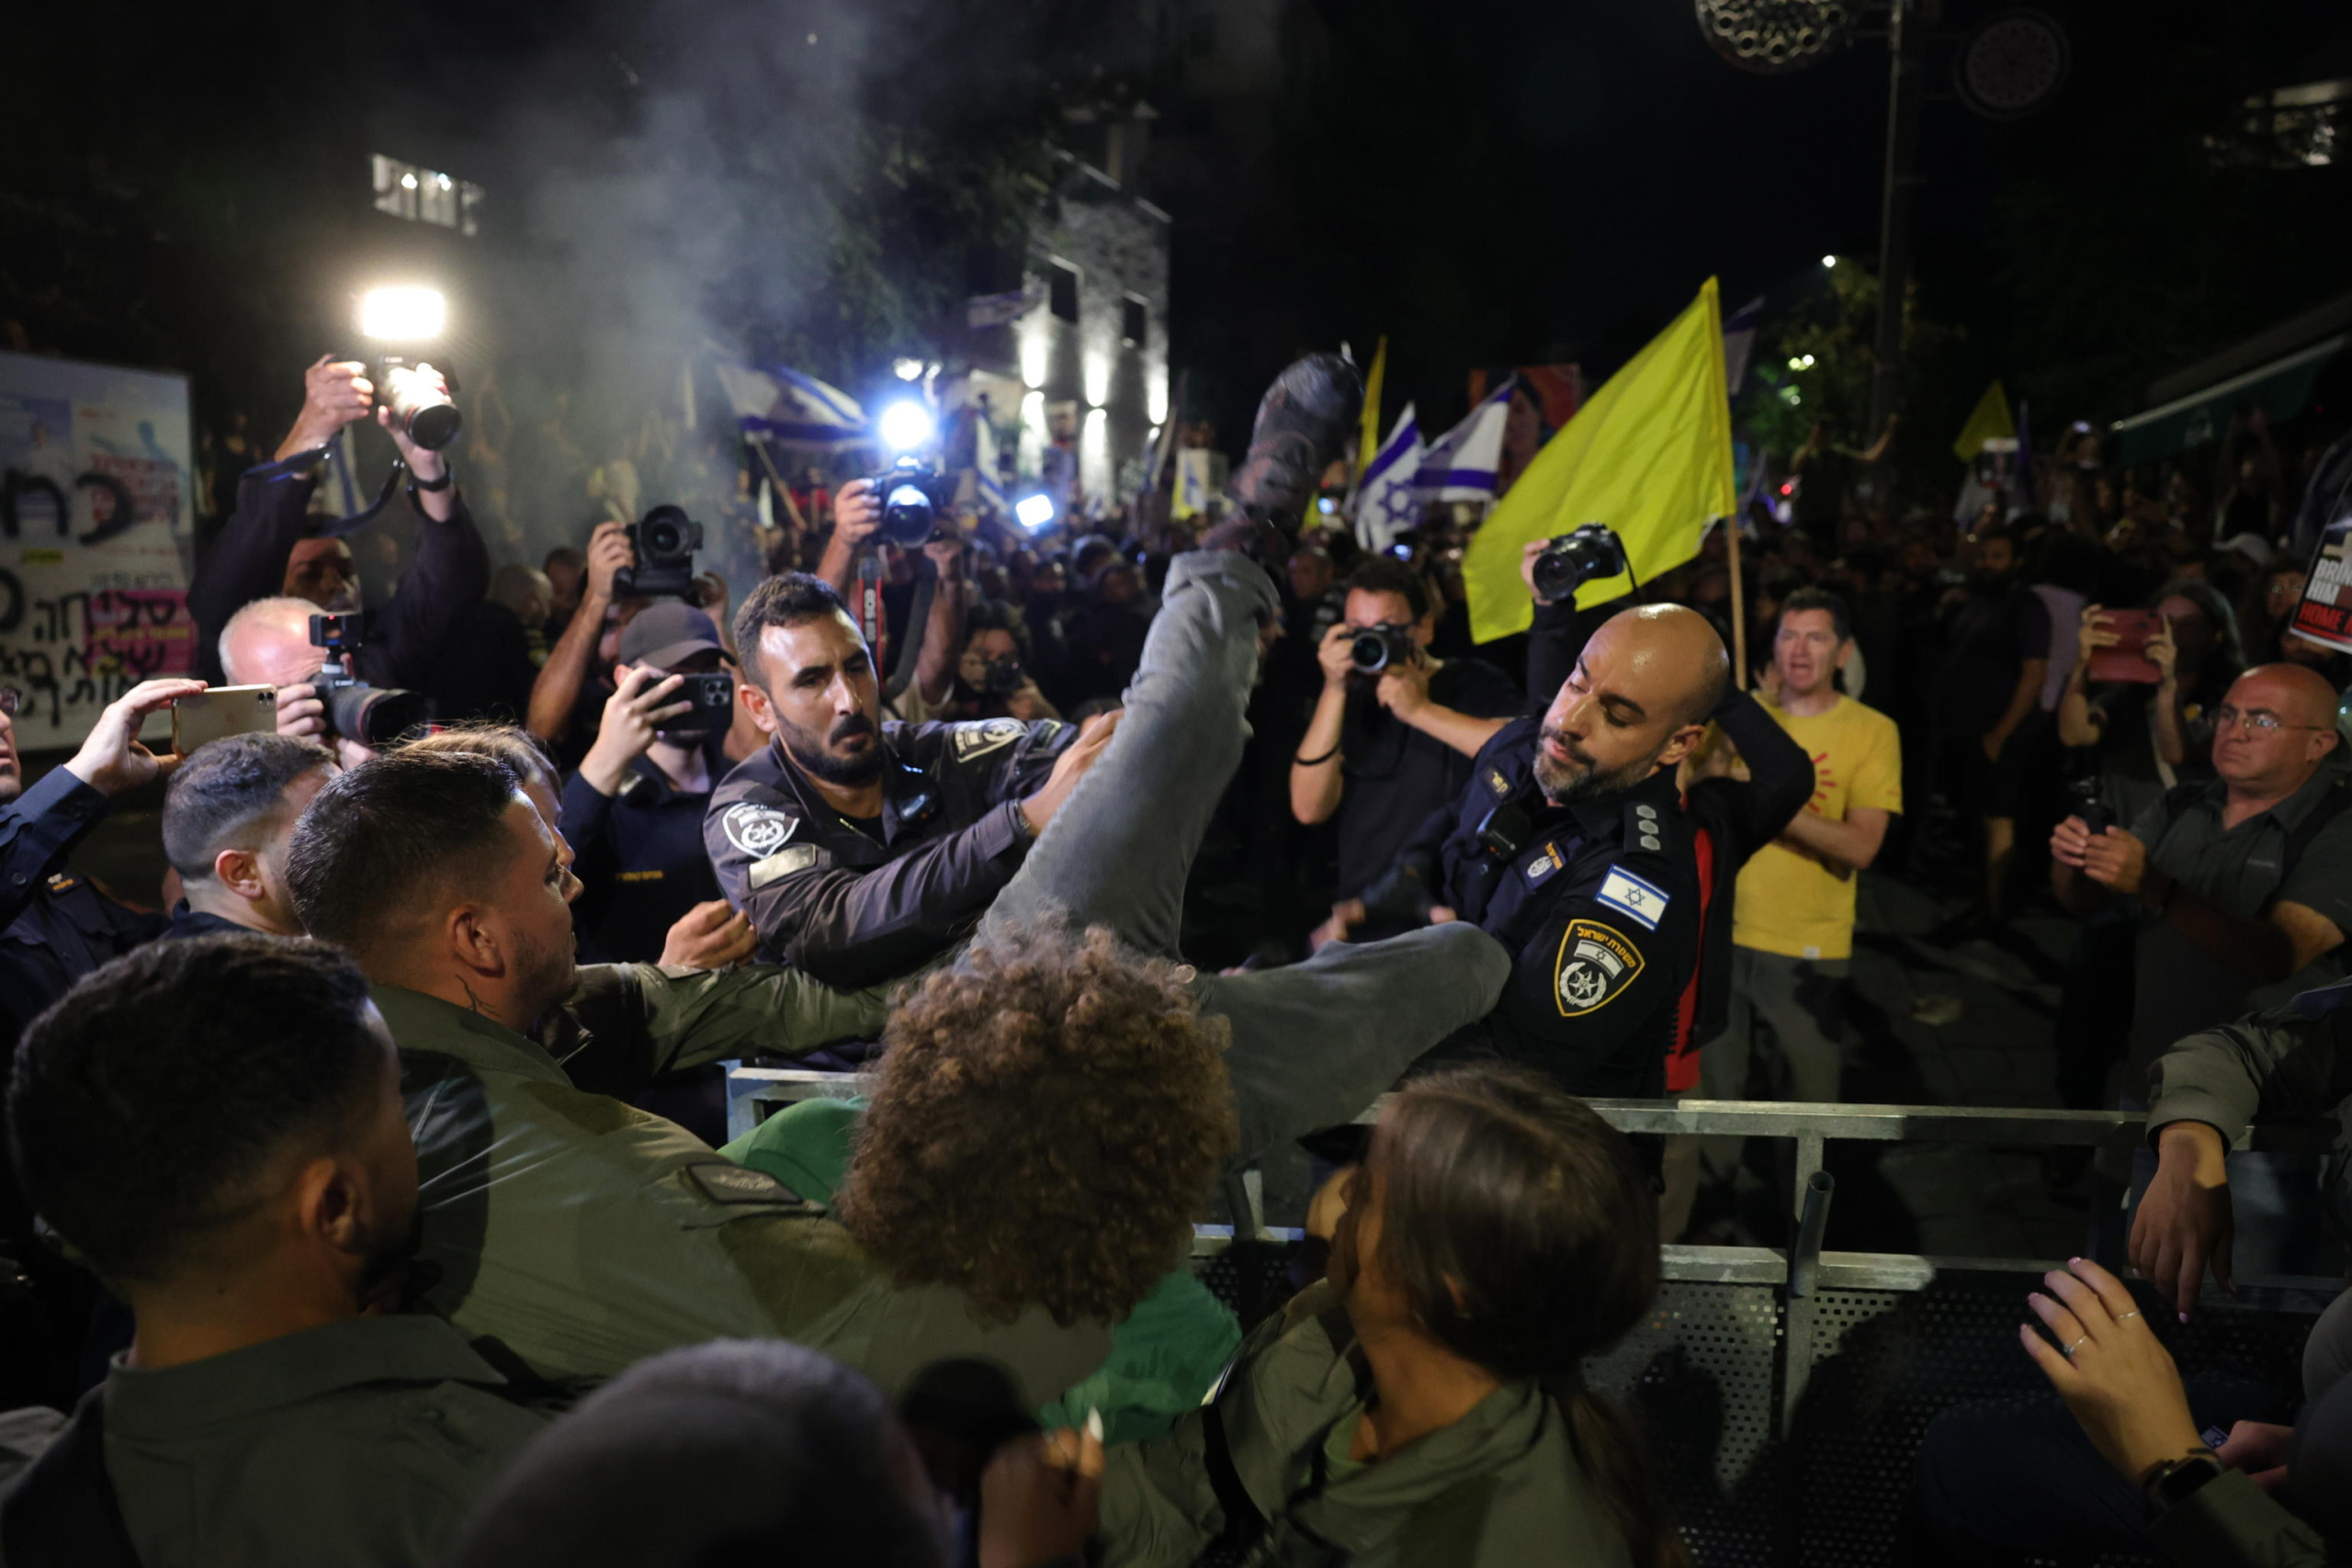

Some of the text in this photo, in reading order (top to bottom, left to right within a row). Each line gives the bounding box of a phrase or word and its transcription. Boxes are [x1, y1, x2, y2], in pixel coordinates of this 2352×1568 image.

[2305, 579, 2341, 605] HIM
[34, 591, 177, 642] סליחה
[2299, 601, 2345, 631] HOME
[1577, 925, 1636, 968] משטרת ישראל
